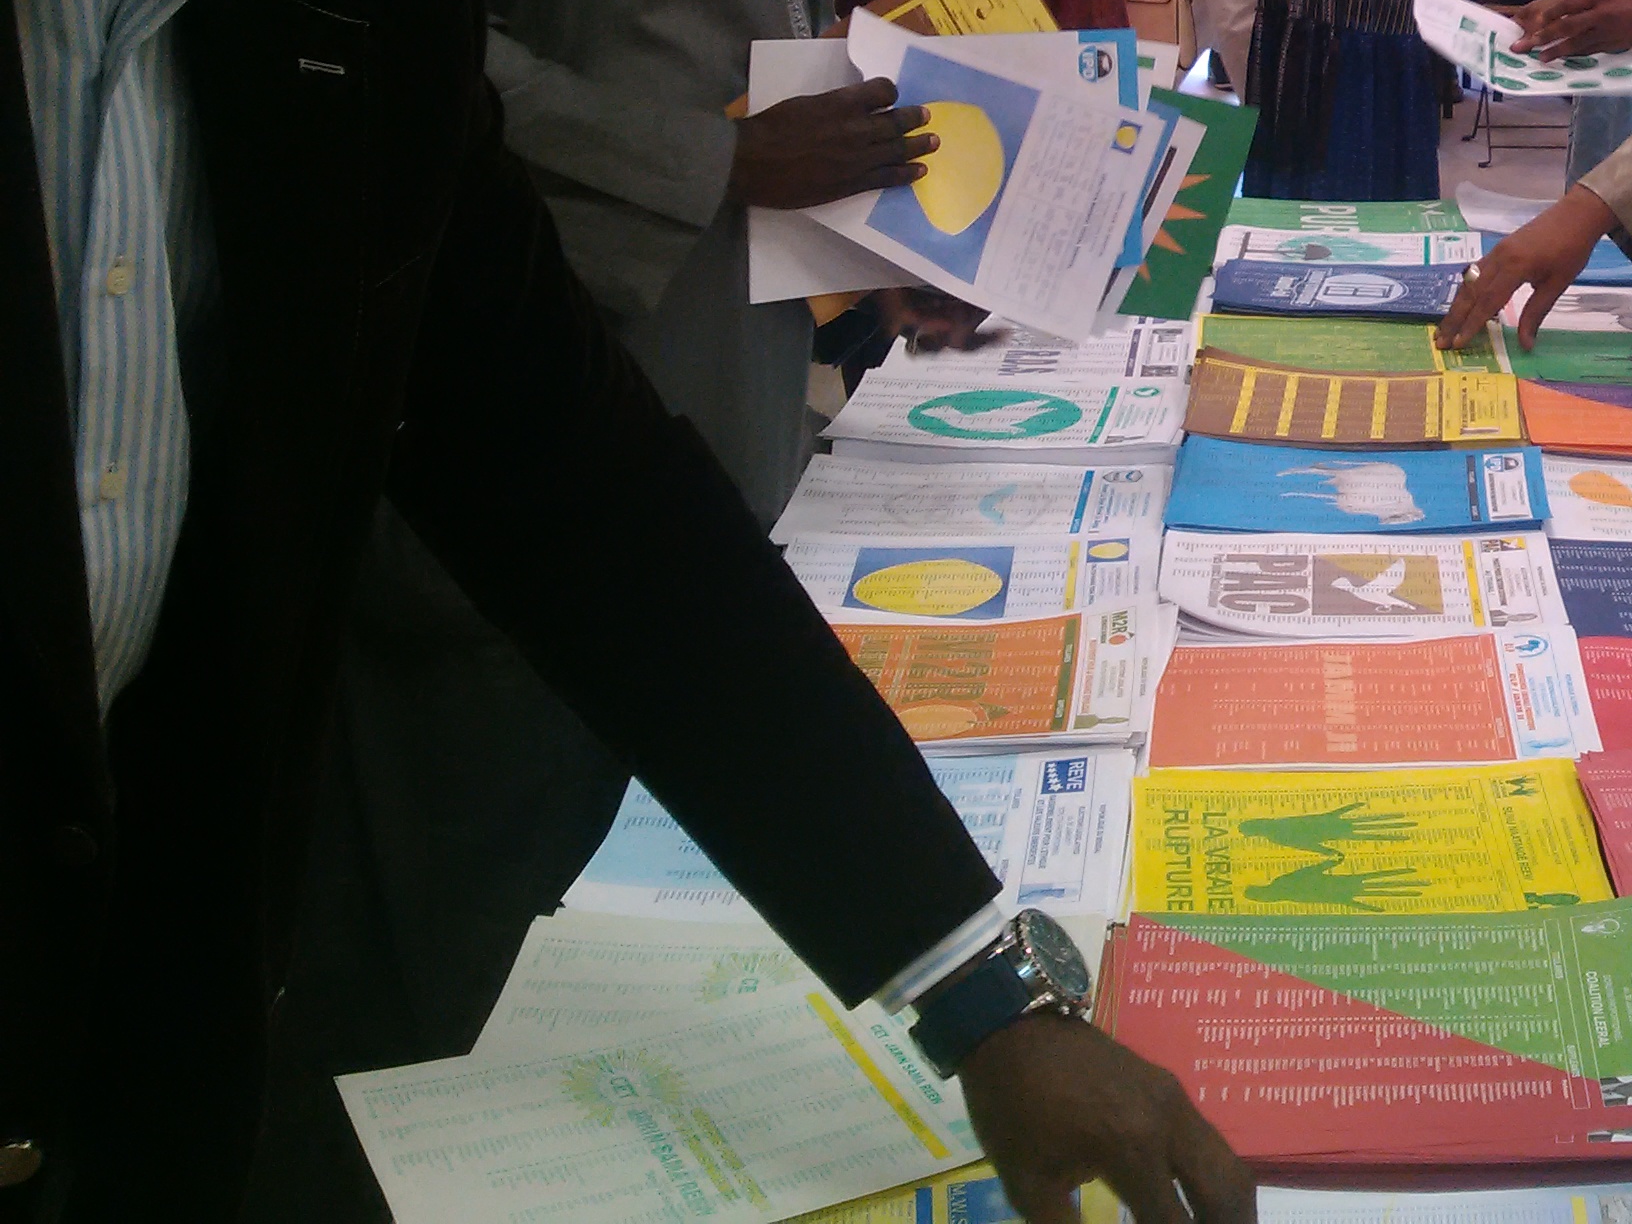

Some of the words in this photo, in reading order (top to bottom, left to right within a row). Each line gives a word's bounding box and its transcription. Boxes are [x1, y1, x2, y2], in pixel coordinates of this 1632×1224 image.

[1219, 553, 1311, 614] PAC
[1111, 610, 1129, 635] M2R
[1066, 761, 1086, 791] REVE
[1203, 812, 1228, 841] LA
[1163, 809, 1194, 911] RUPTURE
[1204, 847, 1235, 911] VRAIE
[1585, 971, 1603, 1015] COALITION
[1594, 1016, 1611, 1048] LEERAL
[611, 1075, 640, 1099] CET
